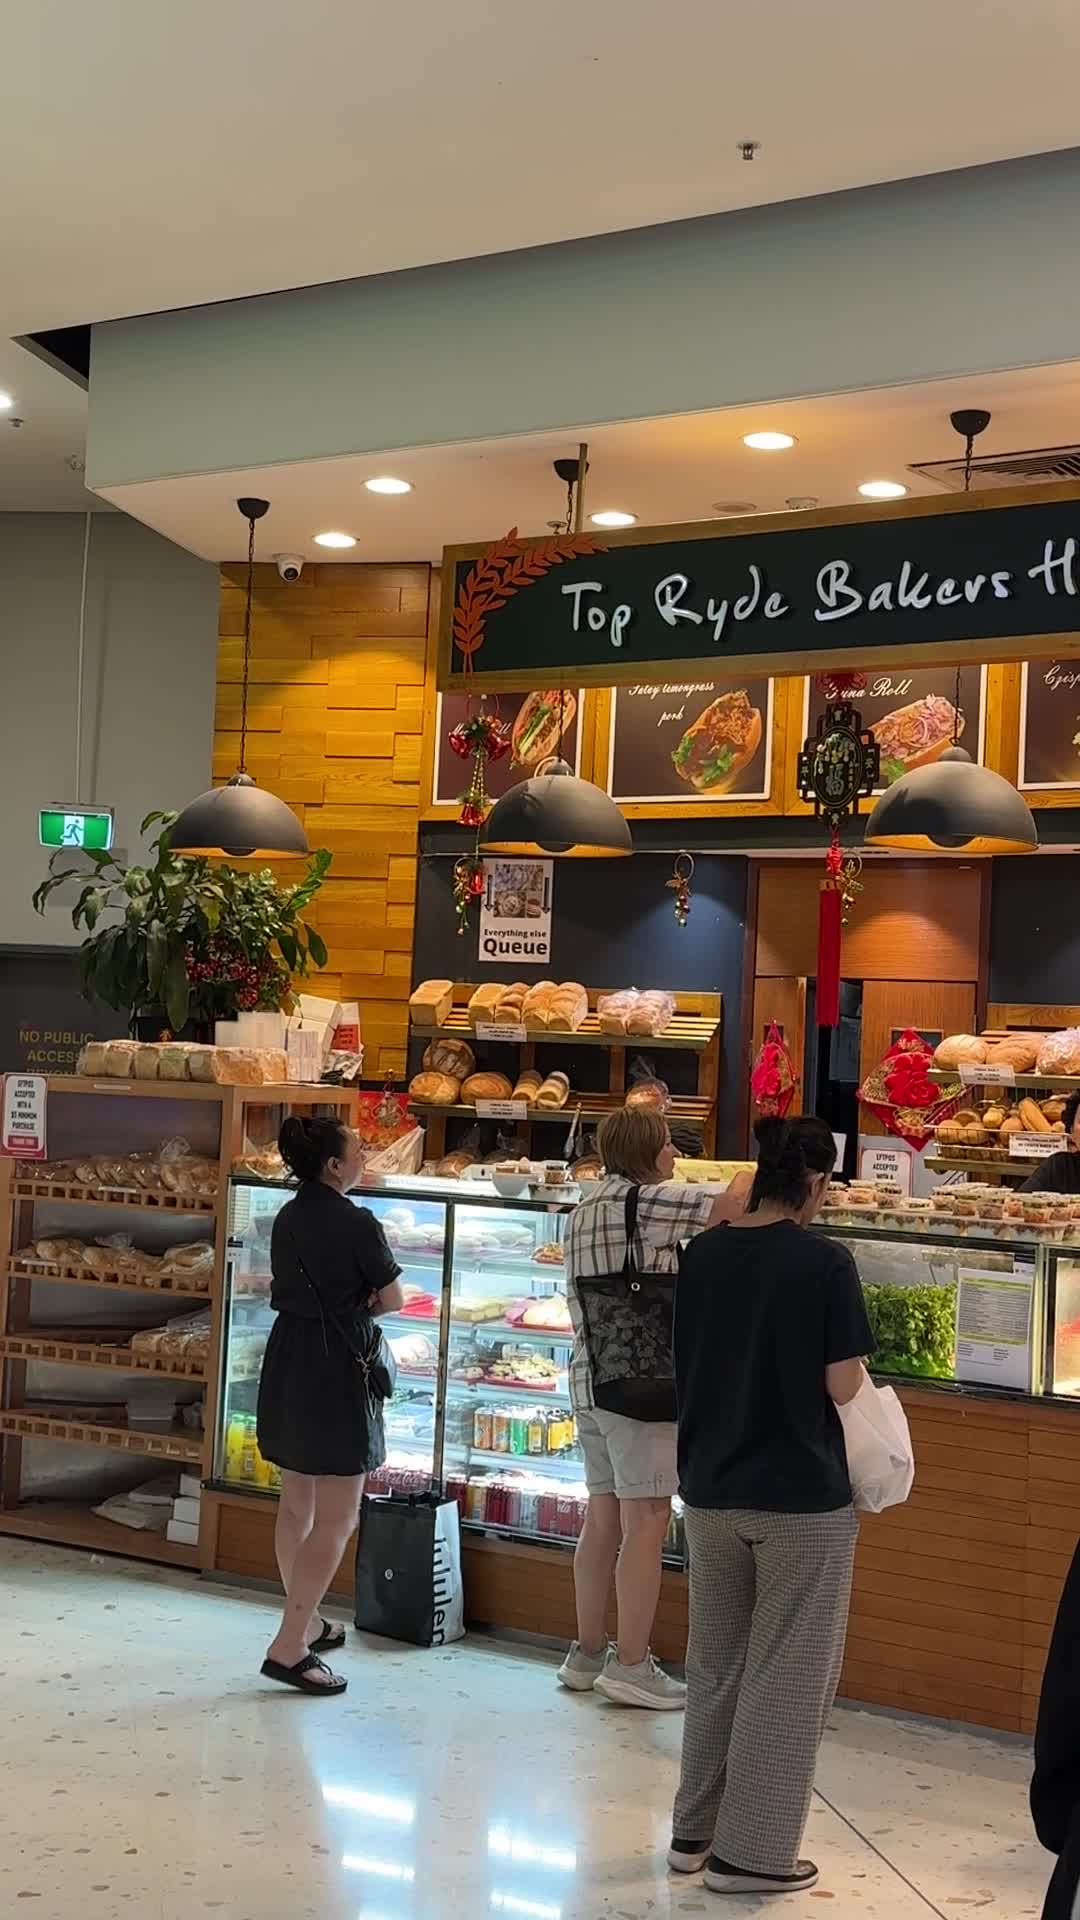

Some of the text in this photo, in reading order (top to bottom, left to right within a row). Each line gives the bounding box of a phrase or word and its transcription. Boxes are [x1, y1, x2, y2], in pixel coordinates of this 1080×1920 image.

[560, 538, 1077, 647] Top Ryde Bakers H
[869, 677, 913, 697] Roll
[657, 704, 684, 727] pork
[484, 929, 547, 938] Everything else
[483, 938, 548, 957] Queue
[20, 1030, 94, 1045] NO PUBLIC
